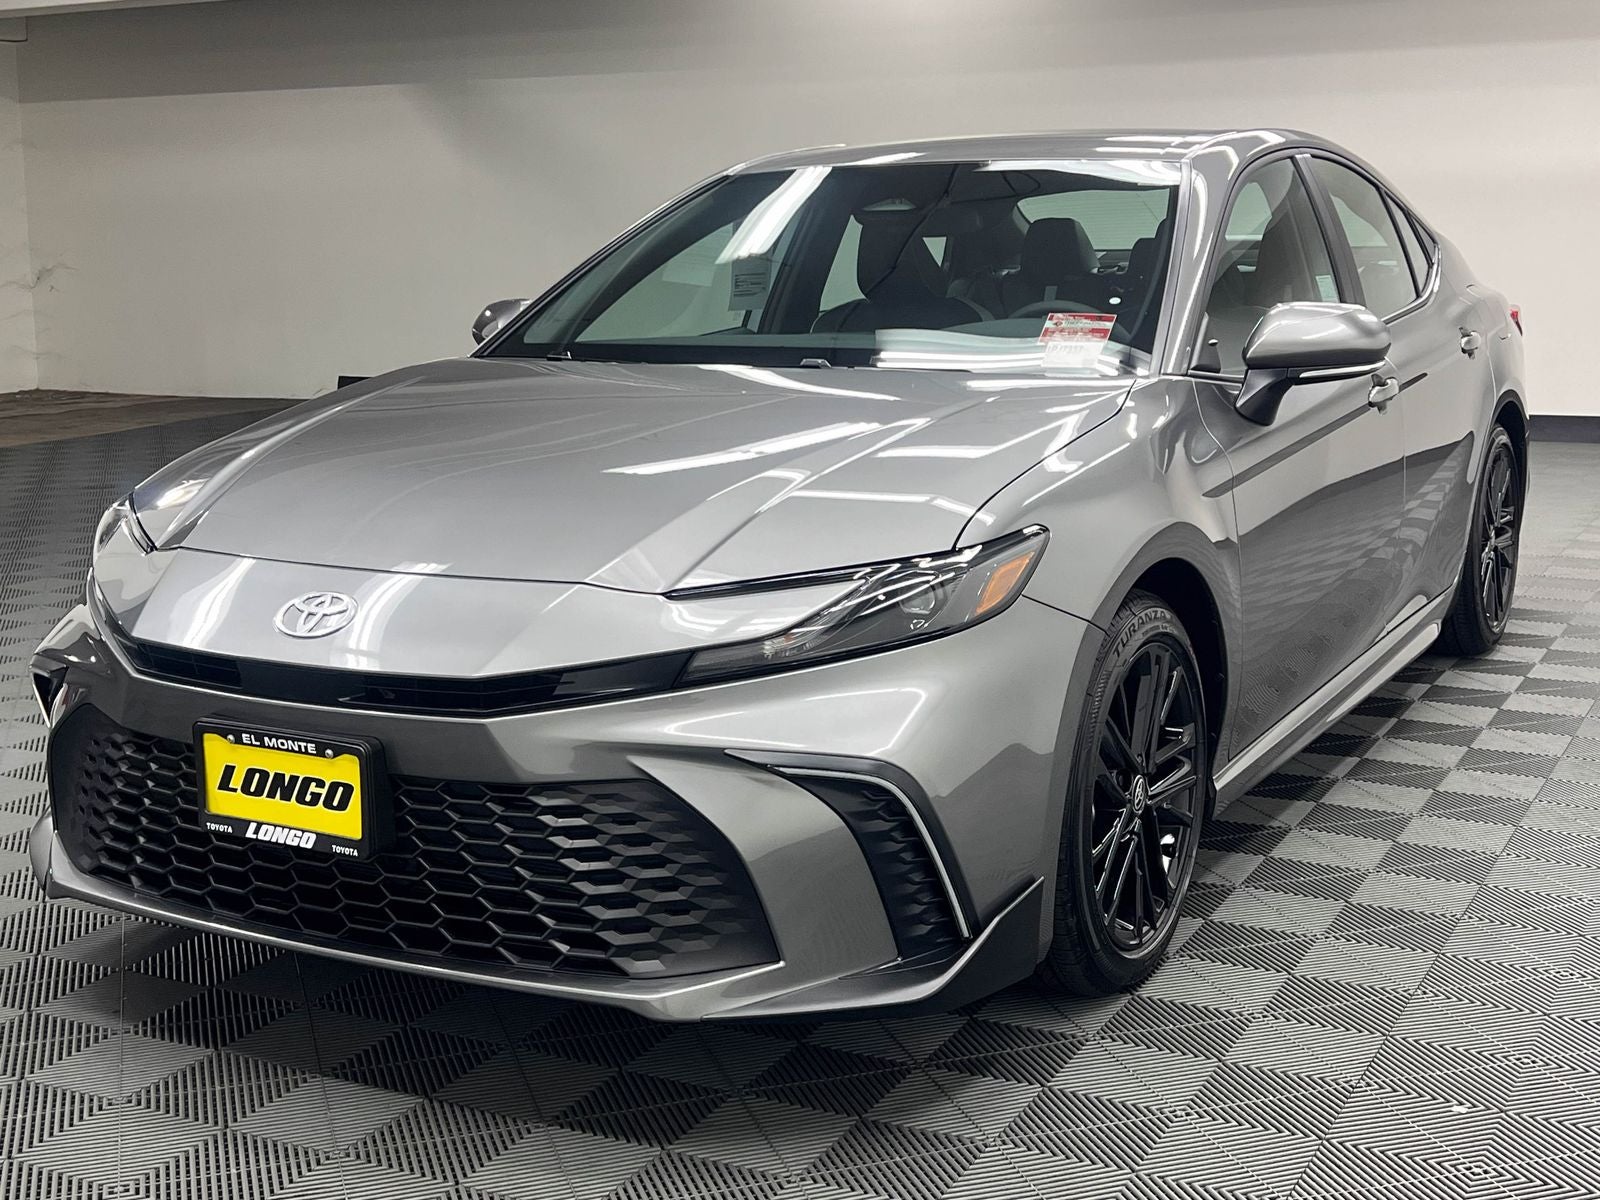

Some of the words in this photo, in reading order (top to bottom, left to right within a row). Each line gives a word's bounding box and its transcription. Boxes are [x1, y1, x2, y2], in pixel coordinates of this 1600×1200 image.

[1112, 609, 1168, 658] TURANZA
[241, 733, 260, 746] EL
[263, 736, 317, 754] MONTE
[216, 764, 355, 812] LONGO
[206, 822, 233, 834] TOYOTA
[245, 822, 317, 849] LONGO
[331, 844, 358, 857] TOYOTA
